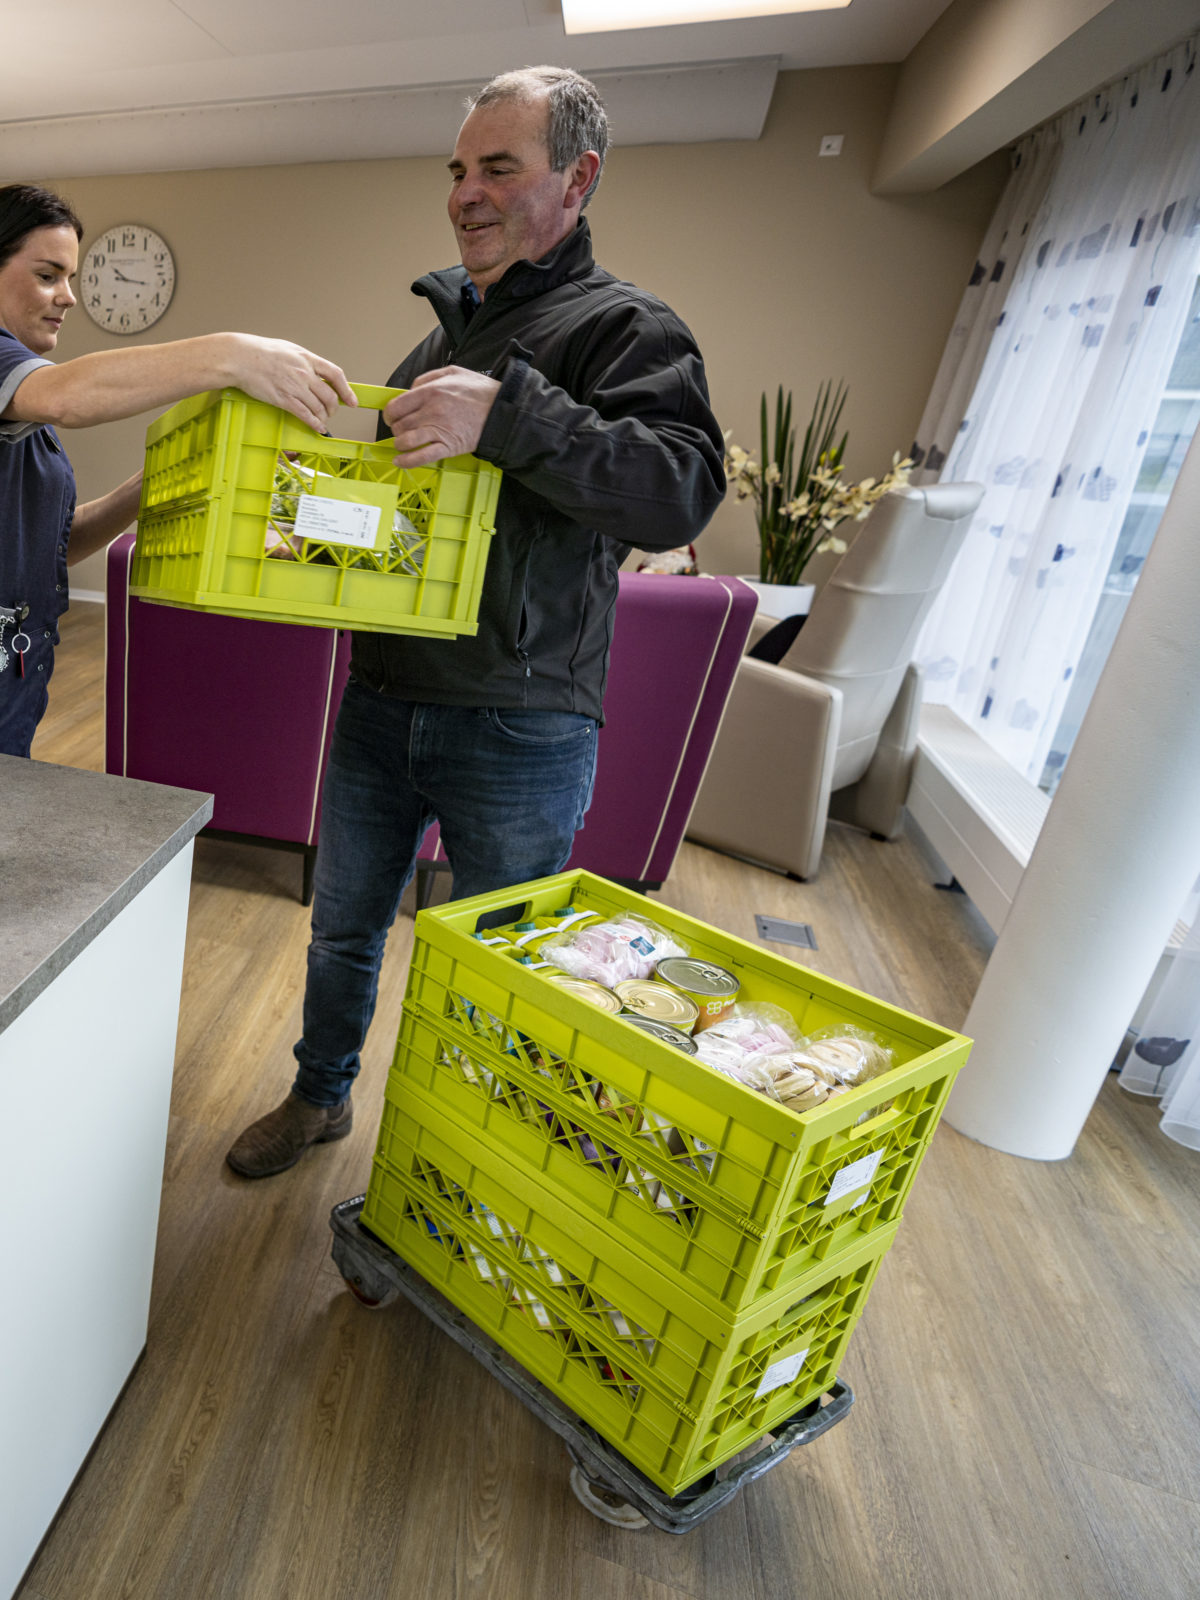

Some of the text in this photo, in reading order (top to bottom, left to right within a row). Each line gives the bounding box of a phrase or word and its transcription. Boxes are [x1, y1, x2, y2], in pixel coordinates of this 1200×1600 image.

[107, 239, 116, 253] 11
[122, 232, 136, 247] 12
[93, 254, 106, 268] 10
[88, 273, 98, 286] 9
[91, 293, 101, 307] 8
[150, 292, 160, 307] 4
[106, 308, 114, 322] 7
[120, 313, 130, 326] 6
[139, 308, 147, 322] 5
